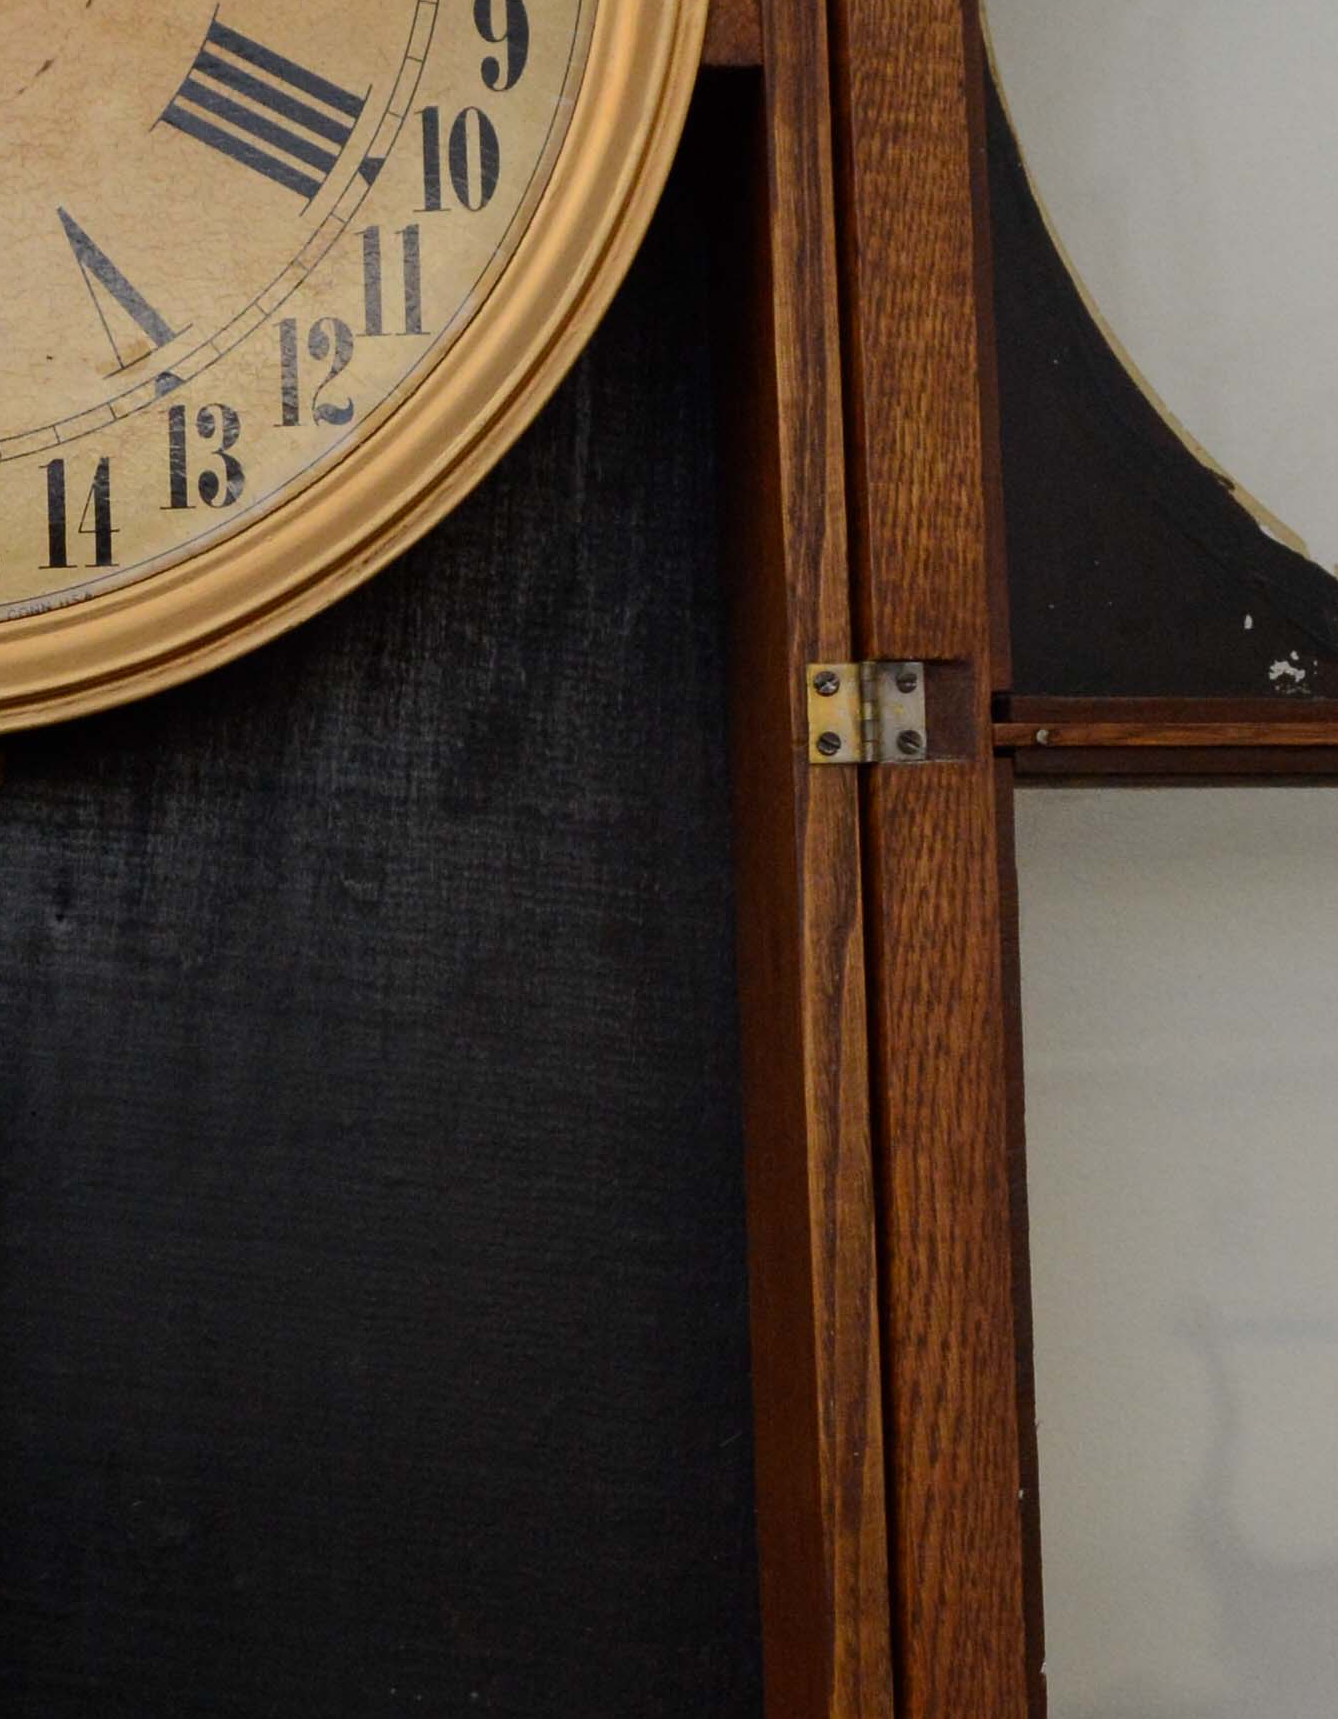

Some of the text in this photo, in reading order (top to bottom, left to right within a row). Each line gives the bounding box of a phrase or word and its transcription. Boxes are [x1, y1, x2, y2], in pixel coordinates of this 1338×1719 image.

[412, 106, 501, 213] 10
[354, 223, 431, 337] 11
[273, 317, 355, 428] 12
[159, 403, 246, 511] 13
[38, 456, 120, 570] 14
